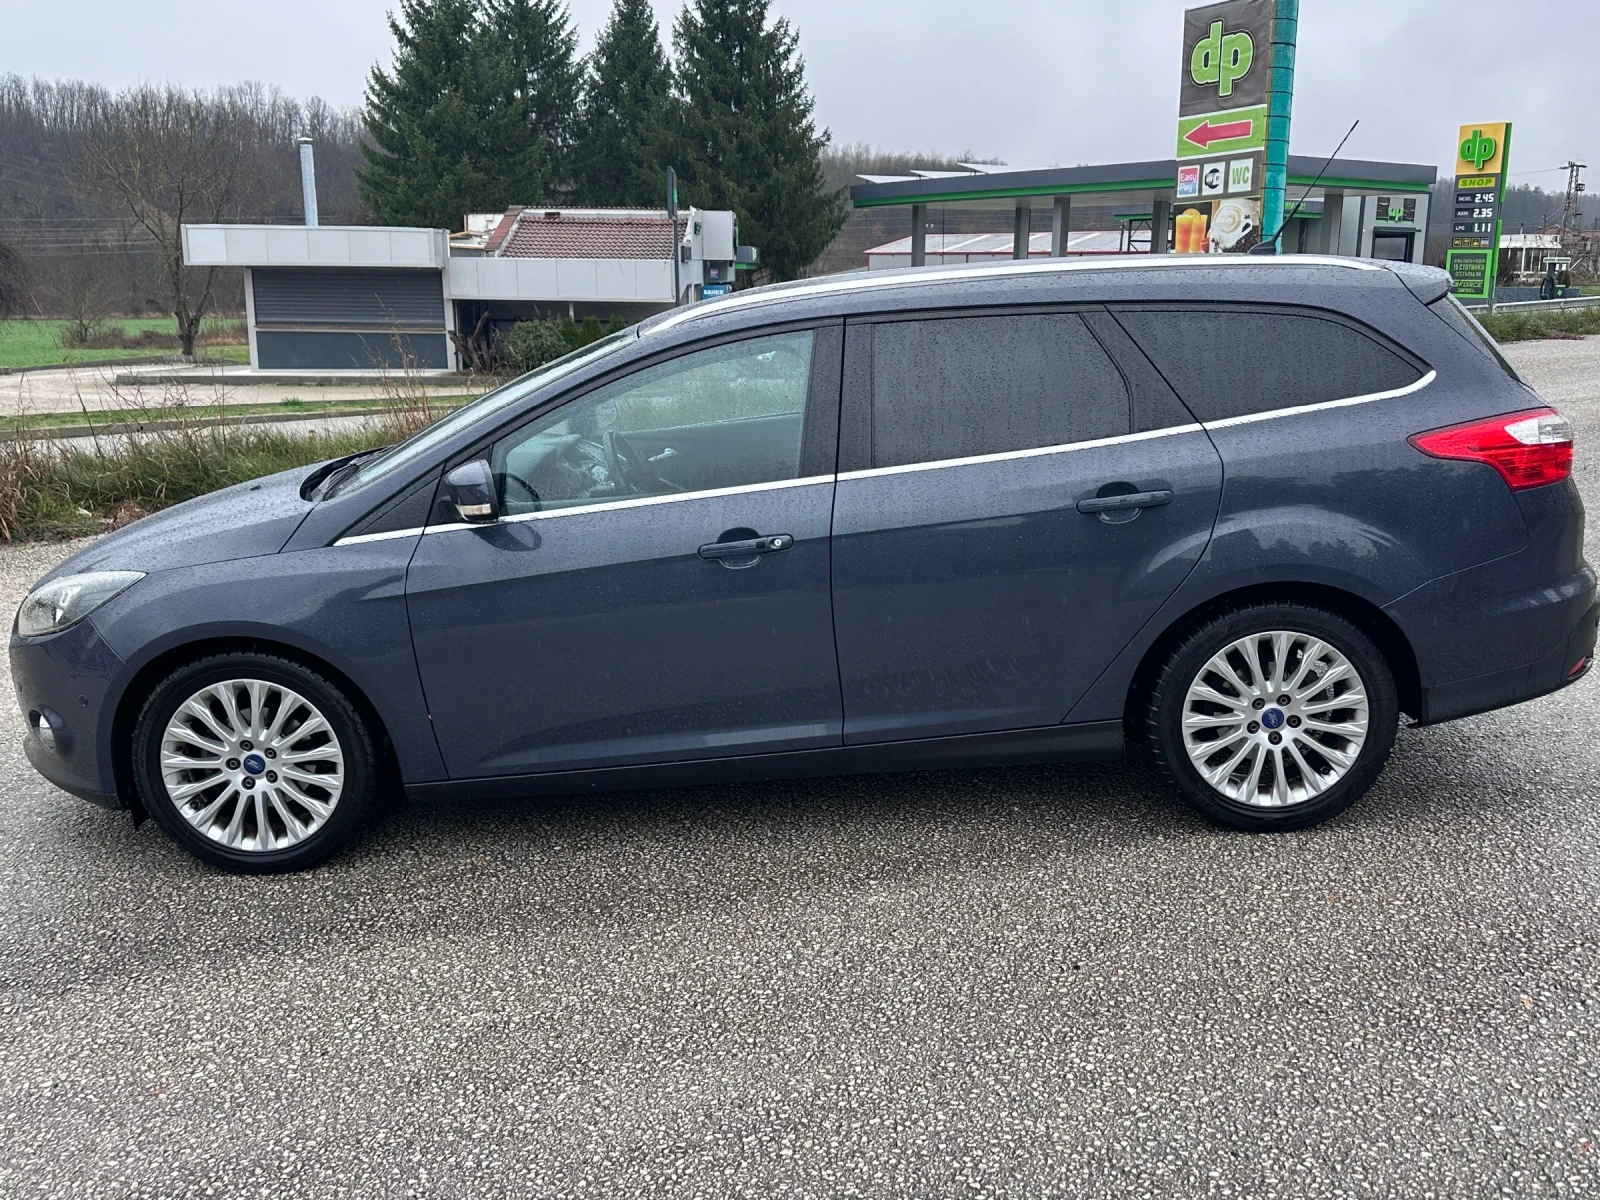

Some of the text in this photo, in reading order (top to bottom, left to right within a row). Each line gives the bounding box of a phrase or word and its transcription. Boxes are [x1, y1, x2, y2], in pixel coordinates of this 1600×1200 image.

[1190, 19, 1254, 98] dp
[1460, 130, 1496, 170] dp
[1180, 173, 1197, 183] Easy
[1232, 166, 1250, 185] WC
[1180, 183, 1193, 192] Pay
[1460, 178, 1493, 187] SHOP
[1475, 193, 1495, 203] 2.45
[1473, 208, 1493, 218] 2.35
[1474, 222, 1491, 233] 1.11
